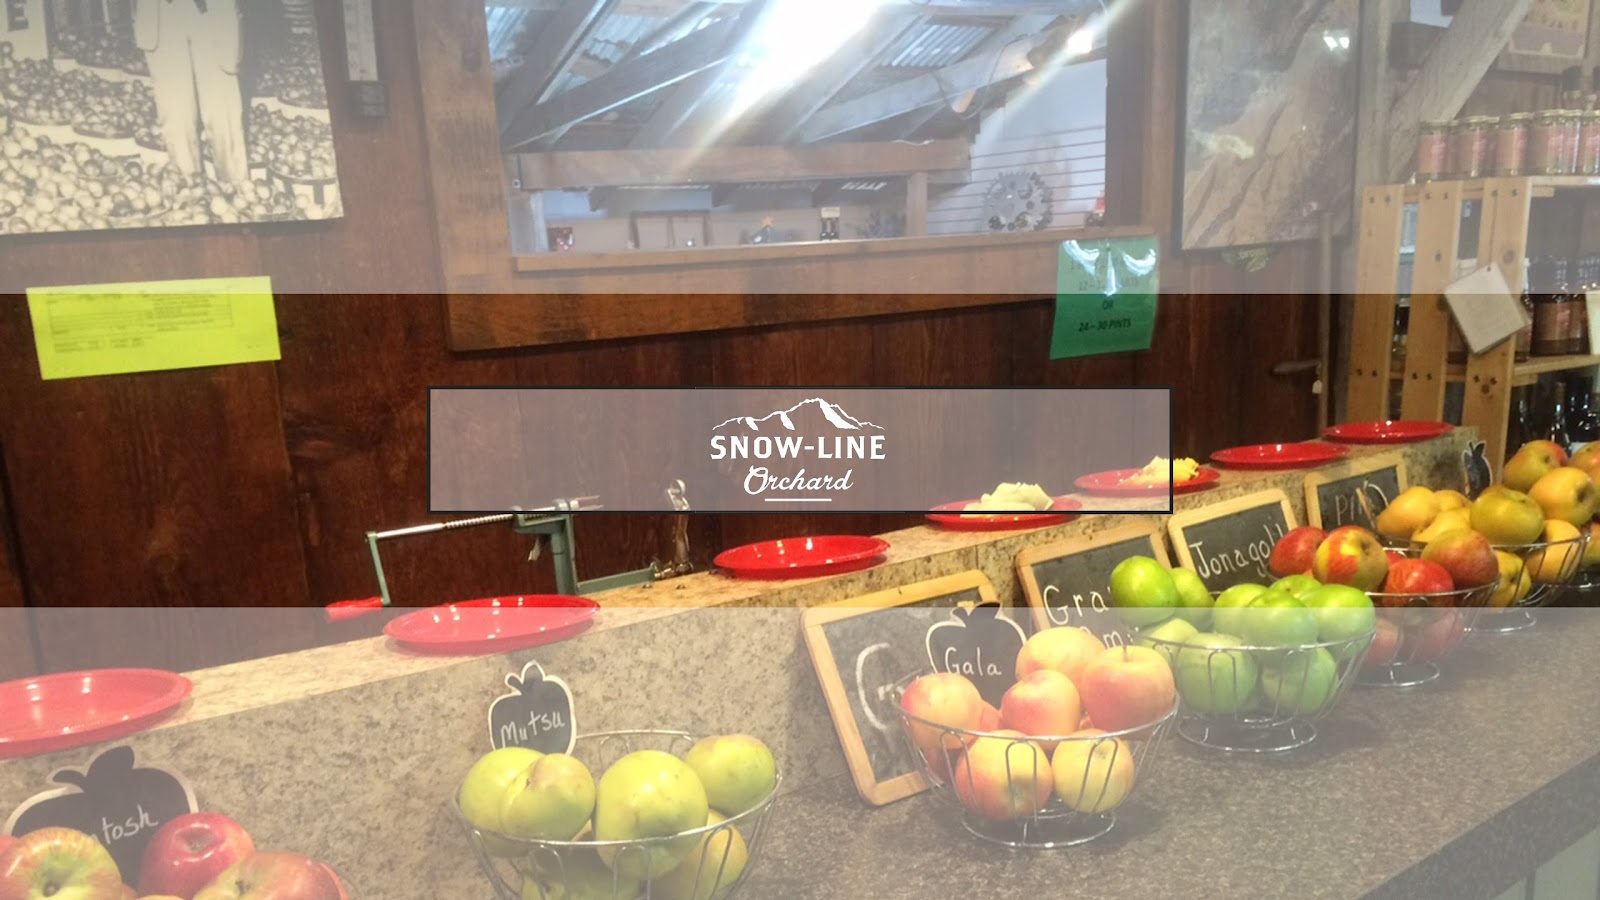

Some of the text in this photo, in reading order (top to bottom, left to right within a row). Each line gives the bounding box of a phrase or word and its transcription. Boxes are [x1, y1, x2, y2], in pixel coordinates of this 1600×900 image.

[1042, 584, 1112, 626] Gra
[944, 646, 1002, 677] Gala
[500, 710, 566, 749] Mutsu
[89, 803, 159, 846] tosh
